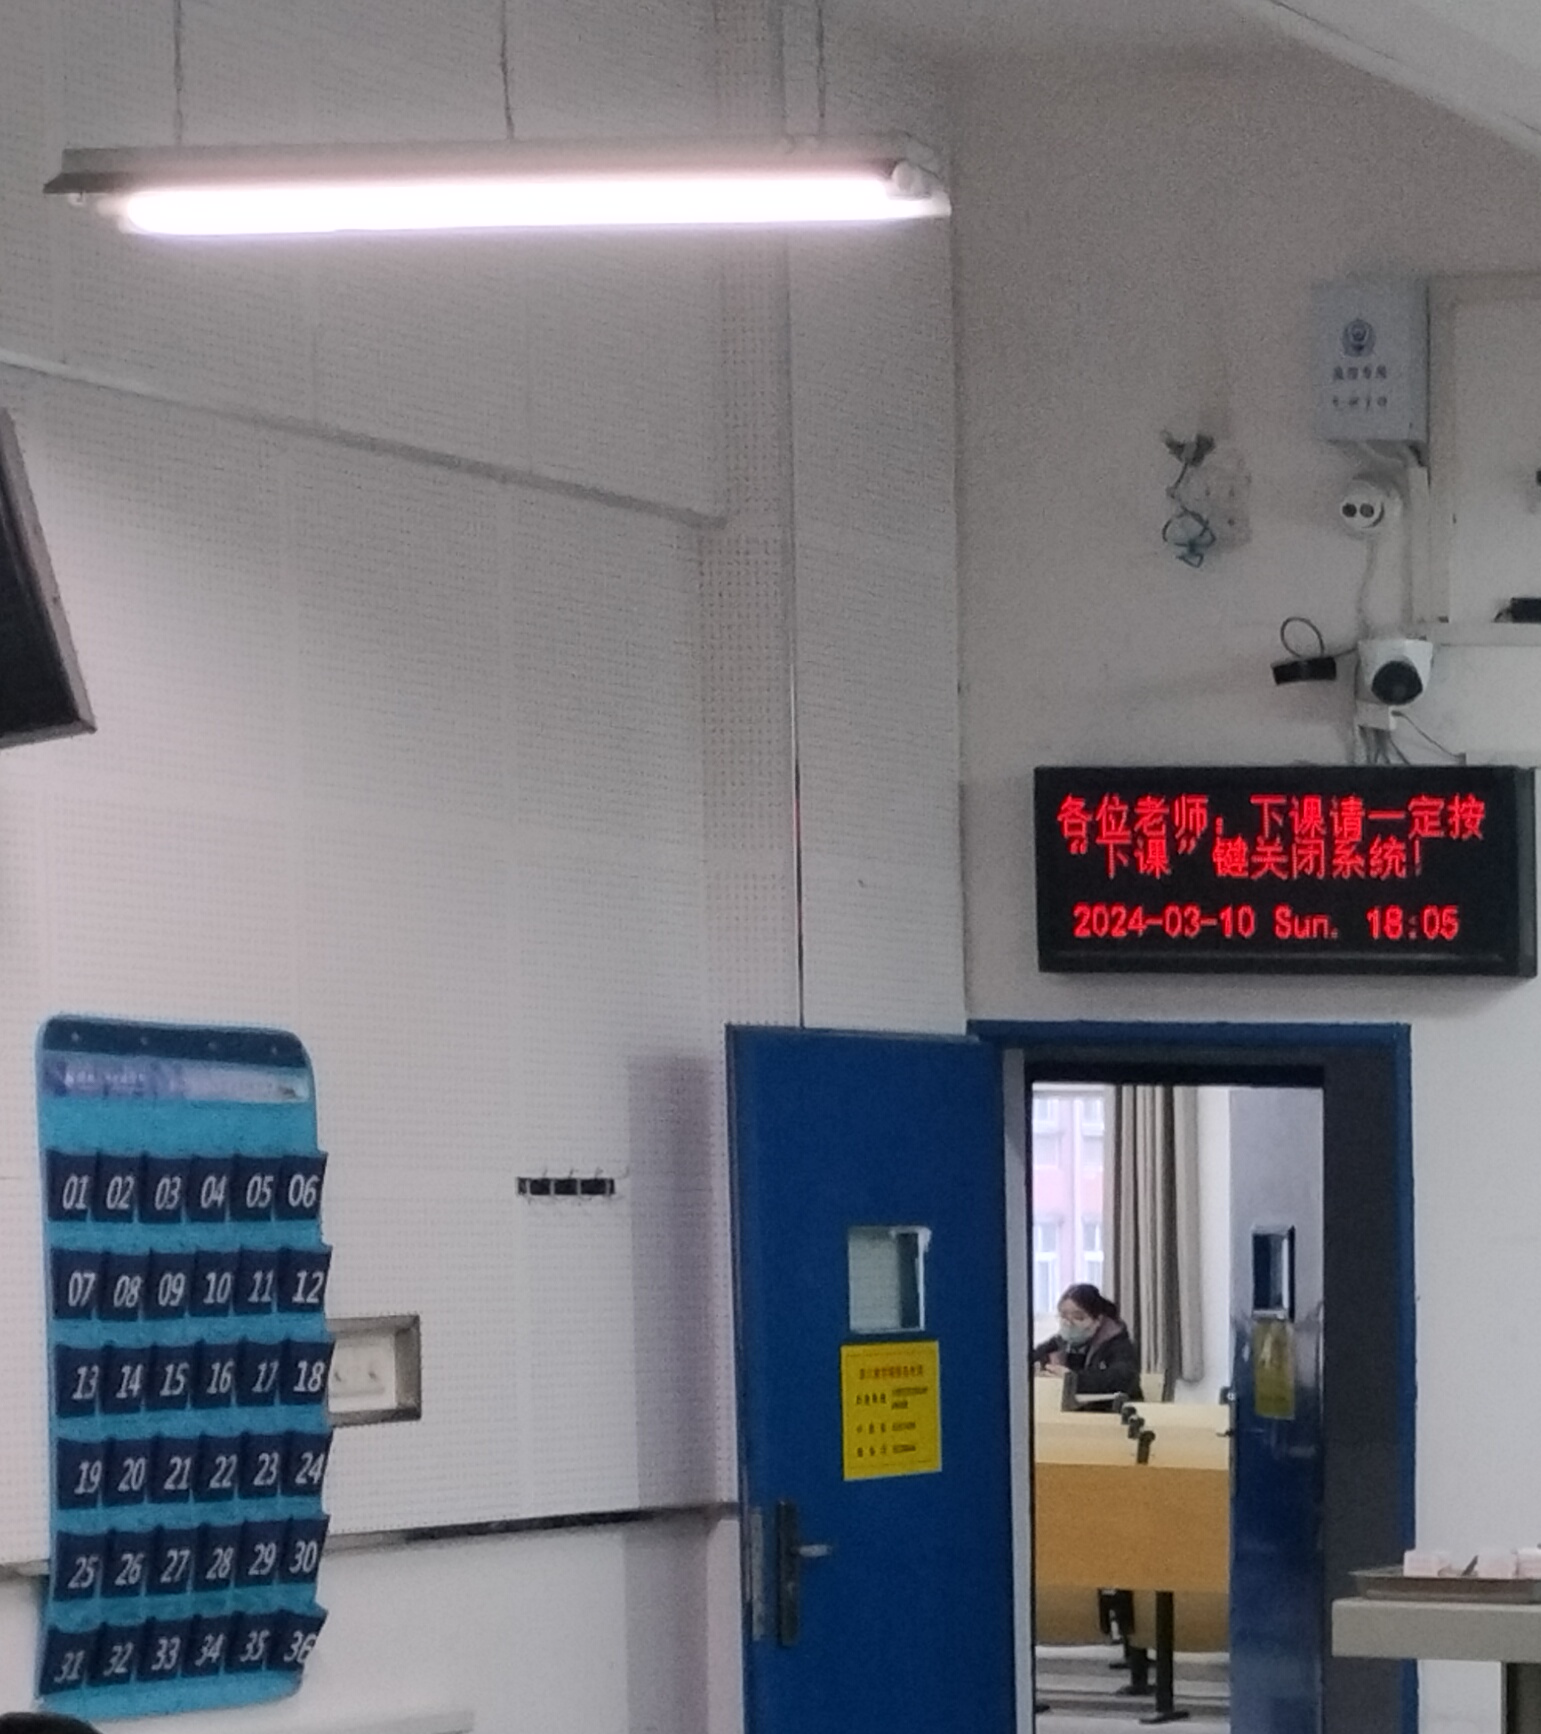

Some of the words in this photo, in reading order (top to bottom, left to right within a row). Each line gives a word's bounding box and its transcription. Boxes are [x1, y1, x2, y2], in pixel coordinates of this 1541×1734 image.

[1073, 903, 1256, 939] 2024-03-10
[1273, 903, 1339, 940] Sun.
[1366, 904, 1460, 940] 18:05
[62, 1174, 89, 1210] 01
[106, 1175, 135, 1210] 02
[154, 1175, 182, 1211] 03
[200, 1175, 228, 1209] 04
[246, 1174, 274, 1208] 05
[288, 1173, 320, 1208] 06
[68, 1270, 97, 1307] 07
[113, 1274, 143, 1308] 08
[158, 1272, 186, 1307] 09
[203, 1271, 232, 1304] 10
[247, 1270, 274, 1303] 11
[292, 1270, 323, 1304] 12
[72, 1364, 100, 1400] 13
[116, 1364, 143, 1399] 14
[159, 1362, 189, 1396] 15
[206, 1360, 235, 1394] 16
[252, 1360, 280, 1393] 17
[293, 1360, 324, 1392] 18
[74, 1460, 103, 1494] 19
[117, 1457, 147, 1492] 20
[163, 1455, 192, 1490] 21
[209, 1454, 237, 1489] 22
[253, 1451, 280, 1486] 23
[295, 1452, 323, 1489] 24
[67, 1555, 98, 1589] 25
[114, 1552, 145, 1586] 26
[160, 1548, 190, 1583] 27
[205, 1546, 235, 1580] 28
[248, 1541, 277, 1576] 29
[289, 1540, 318, 1573] 30
[53, 1649, 85, 1683] 31
[103, 1641, 134, 1676] 32
[151, 1636, 181, 1671] 33
[195, 1633, 225, 1667] 34
[239, 1629, 270, 1663] 35
[284, 1630, 316, 1667] 36
